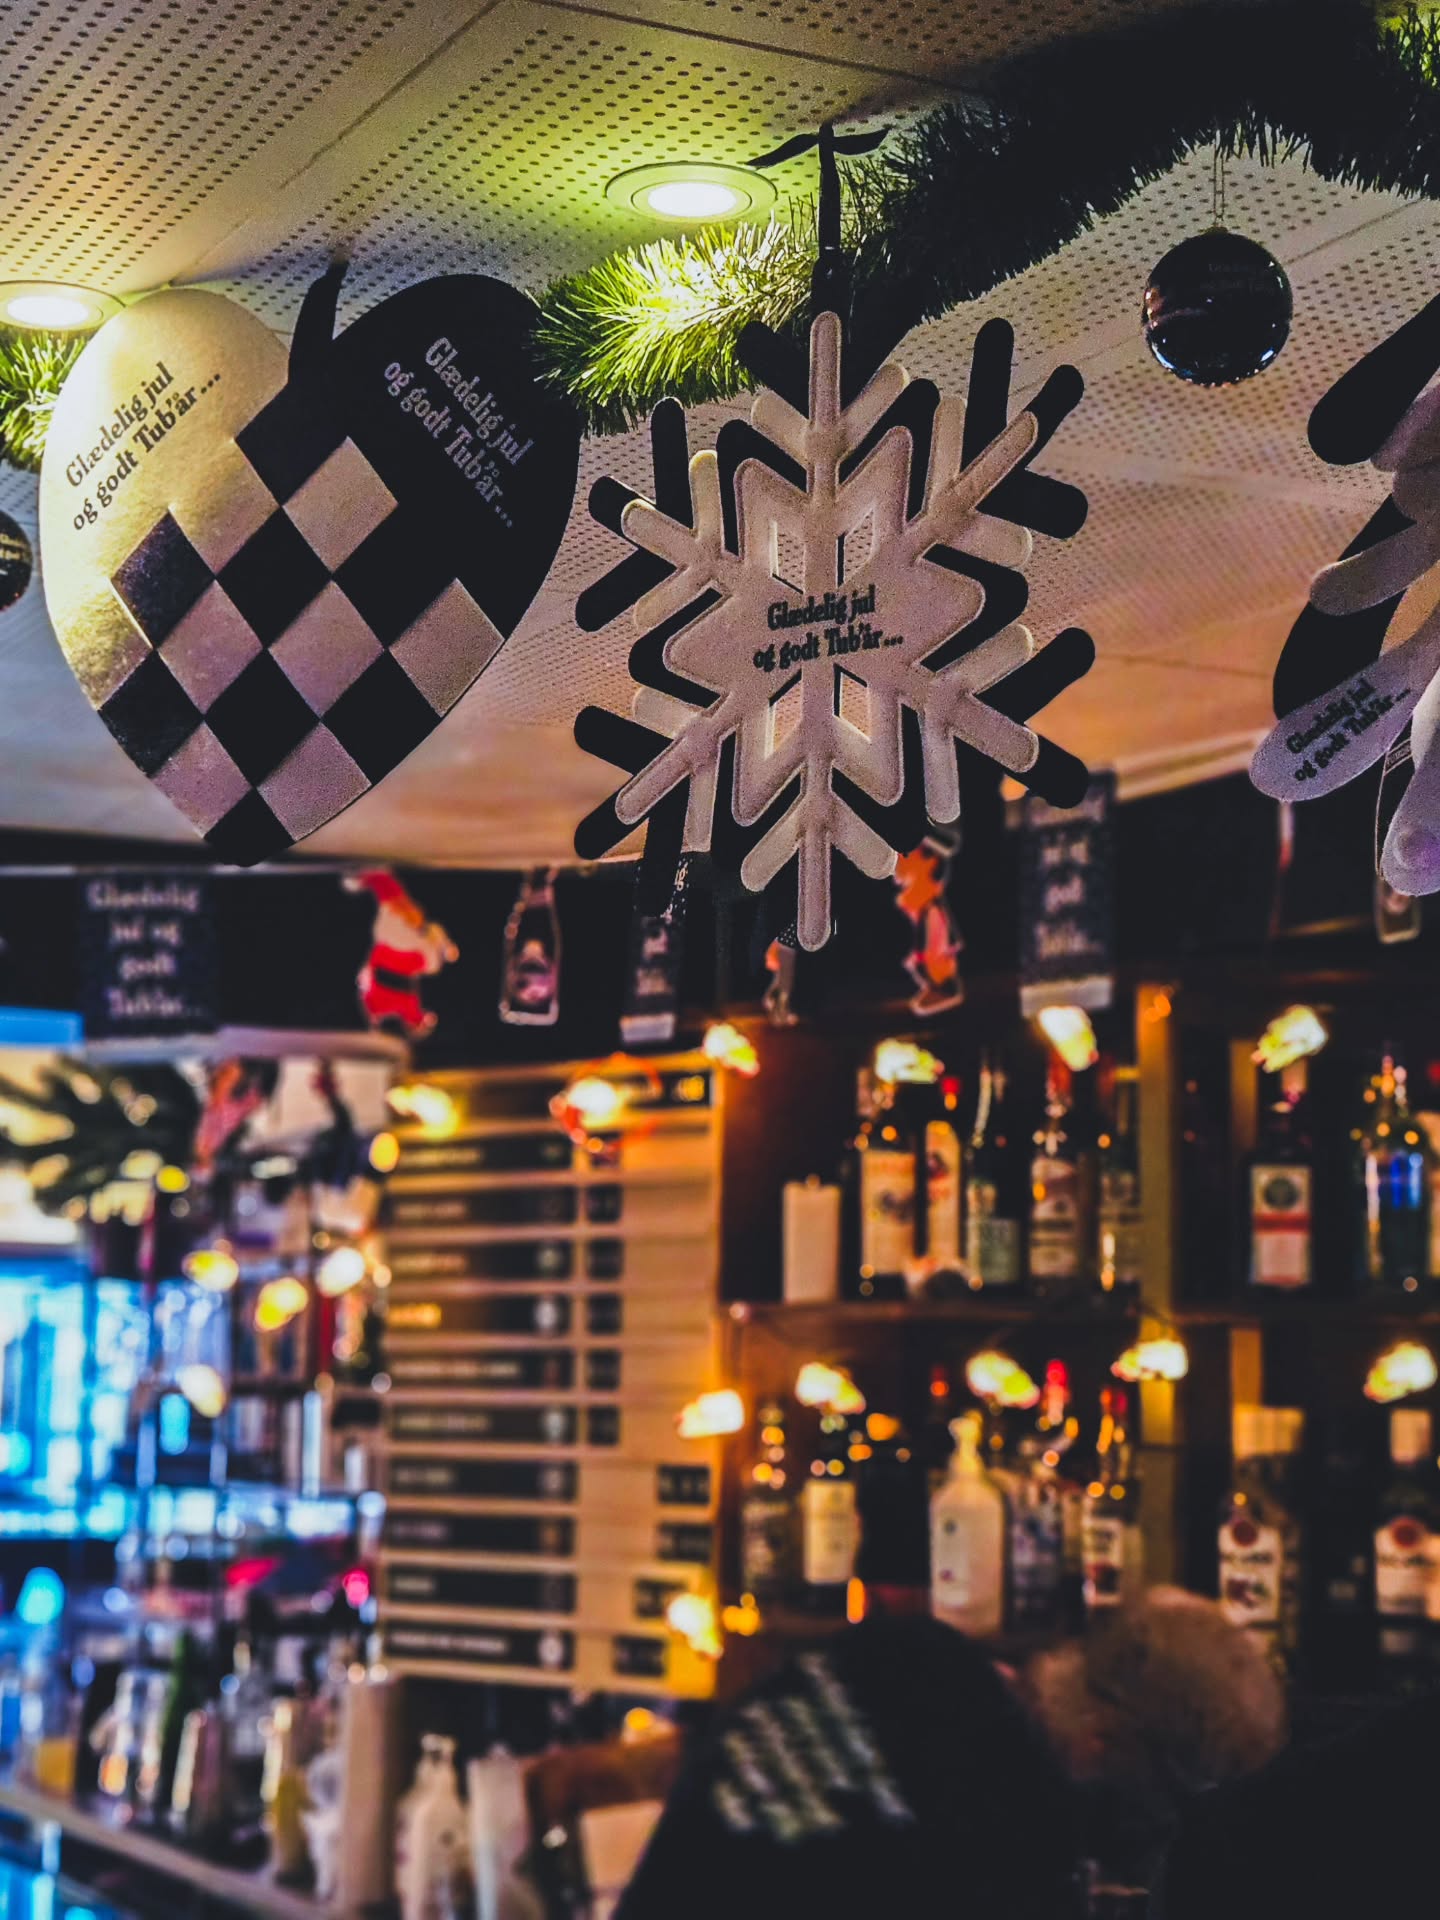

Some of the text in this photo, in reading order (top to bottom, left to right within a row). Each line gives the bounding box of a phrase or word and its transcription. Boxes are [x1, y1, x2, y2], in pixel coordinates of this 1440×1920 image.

[65, 360, 174, 488] Glædelig jul
[384, 362, 415, 397] og
[400, 387, 452, 439] godt
[425, 337, 534, 466] Glædelig jul
[73, 498, 98, 531] og
[96, 449, 139, 509] godt
[848, 583, 876, 623] jul
[753, 643, 776, 673] og
[779, 632, 820, 670] godt
[1295, 760, 1318, 782] og
[1315, 732, 1350, 769] godt
